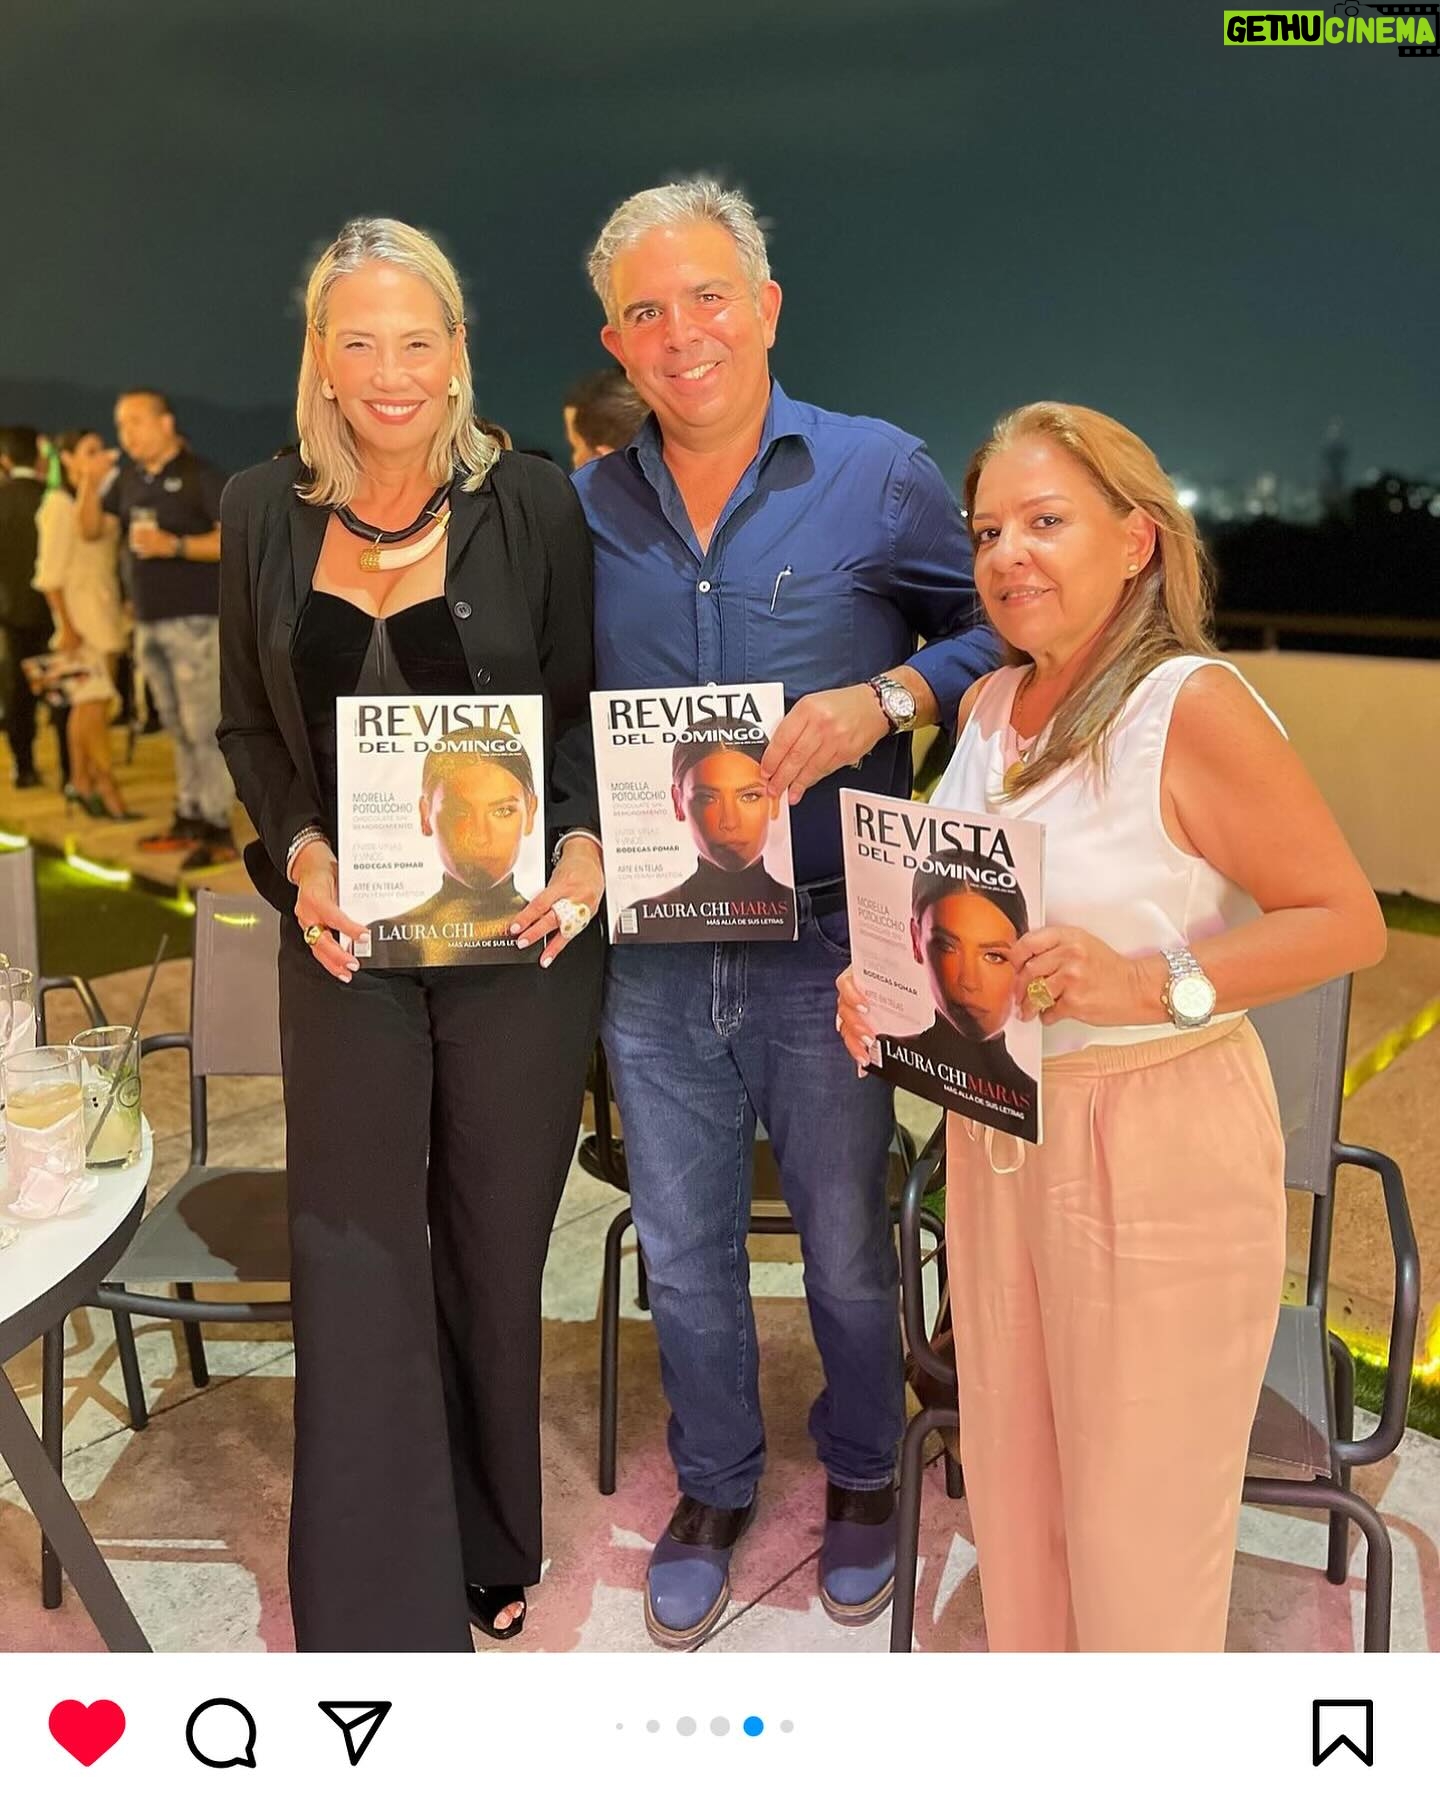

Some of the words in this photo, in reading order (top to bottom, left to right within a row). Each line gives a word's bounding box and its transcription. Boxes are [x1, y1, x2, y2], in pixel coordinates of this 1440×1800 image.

[610, 693, 762, 730] REVISTA
[358, 704, 521, 737] REVISTA
[613, 733, 654, 745] DEL
[663, 728, 765, 744] DOMINGO
[359, 741, 405, 753] DEL
[414, 739, 522, 753] DOMINGO
[611, 782, 649, 791] MORELLA
[352, 792, 395, 803] MORELLA
[855, 803, 1016, 869] REVISTA
[616, 846, 651, 854] BODEGAS
[353, 862, 392, 870] BODEGAS
[858, 843, 896, 865] DEL
[903, 855, 1017, 889] DOMINGO
[643, 903, 697, 919] LAURA
[700, 901, 788, 917] CHIMARAS
[379, 924, 438, 941] LAURA
[493, 939, 506, 947] SUS
[886, 1040, 936, 1078] LAURA
[937, 1063, 1031, 1109] CHIMARAS
[975, 1096, 985, 1106] DE
[985, 1100, 998, 1111] SUS
[999, 1105, 1025, 1120] LETRAS
